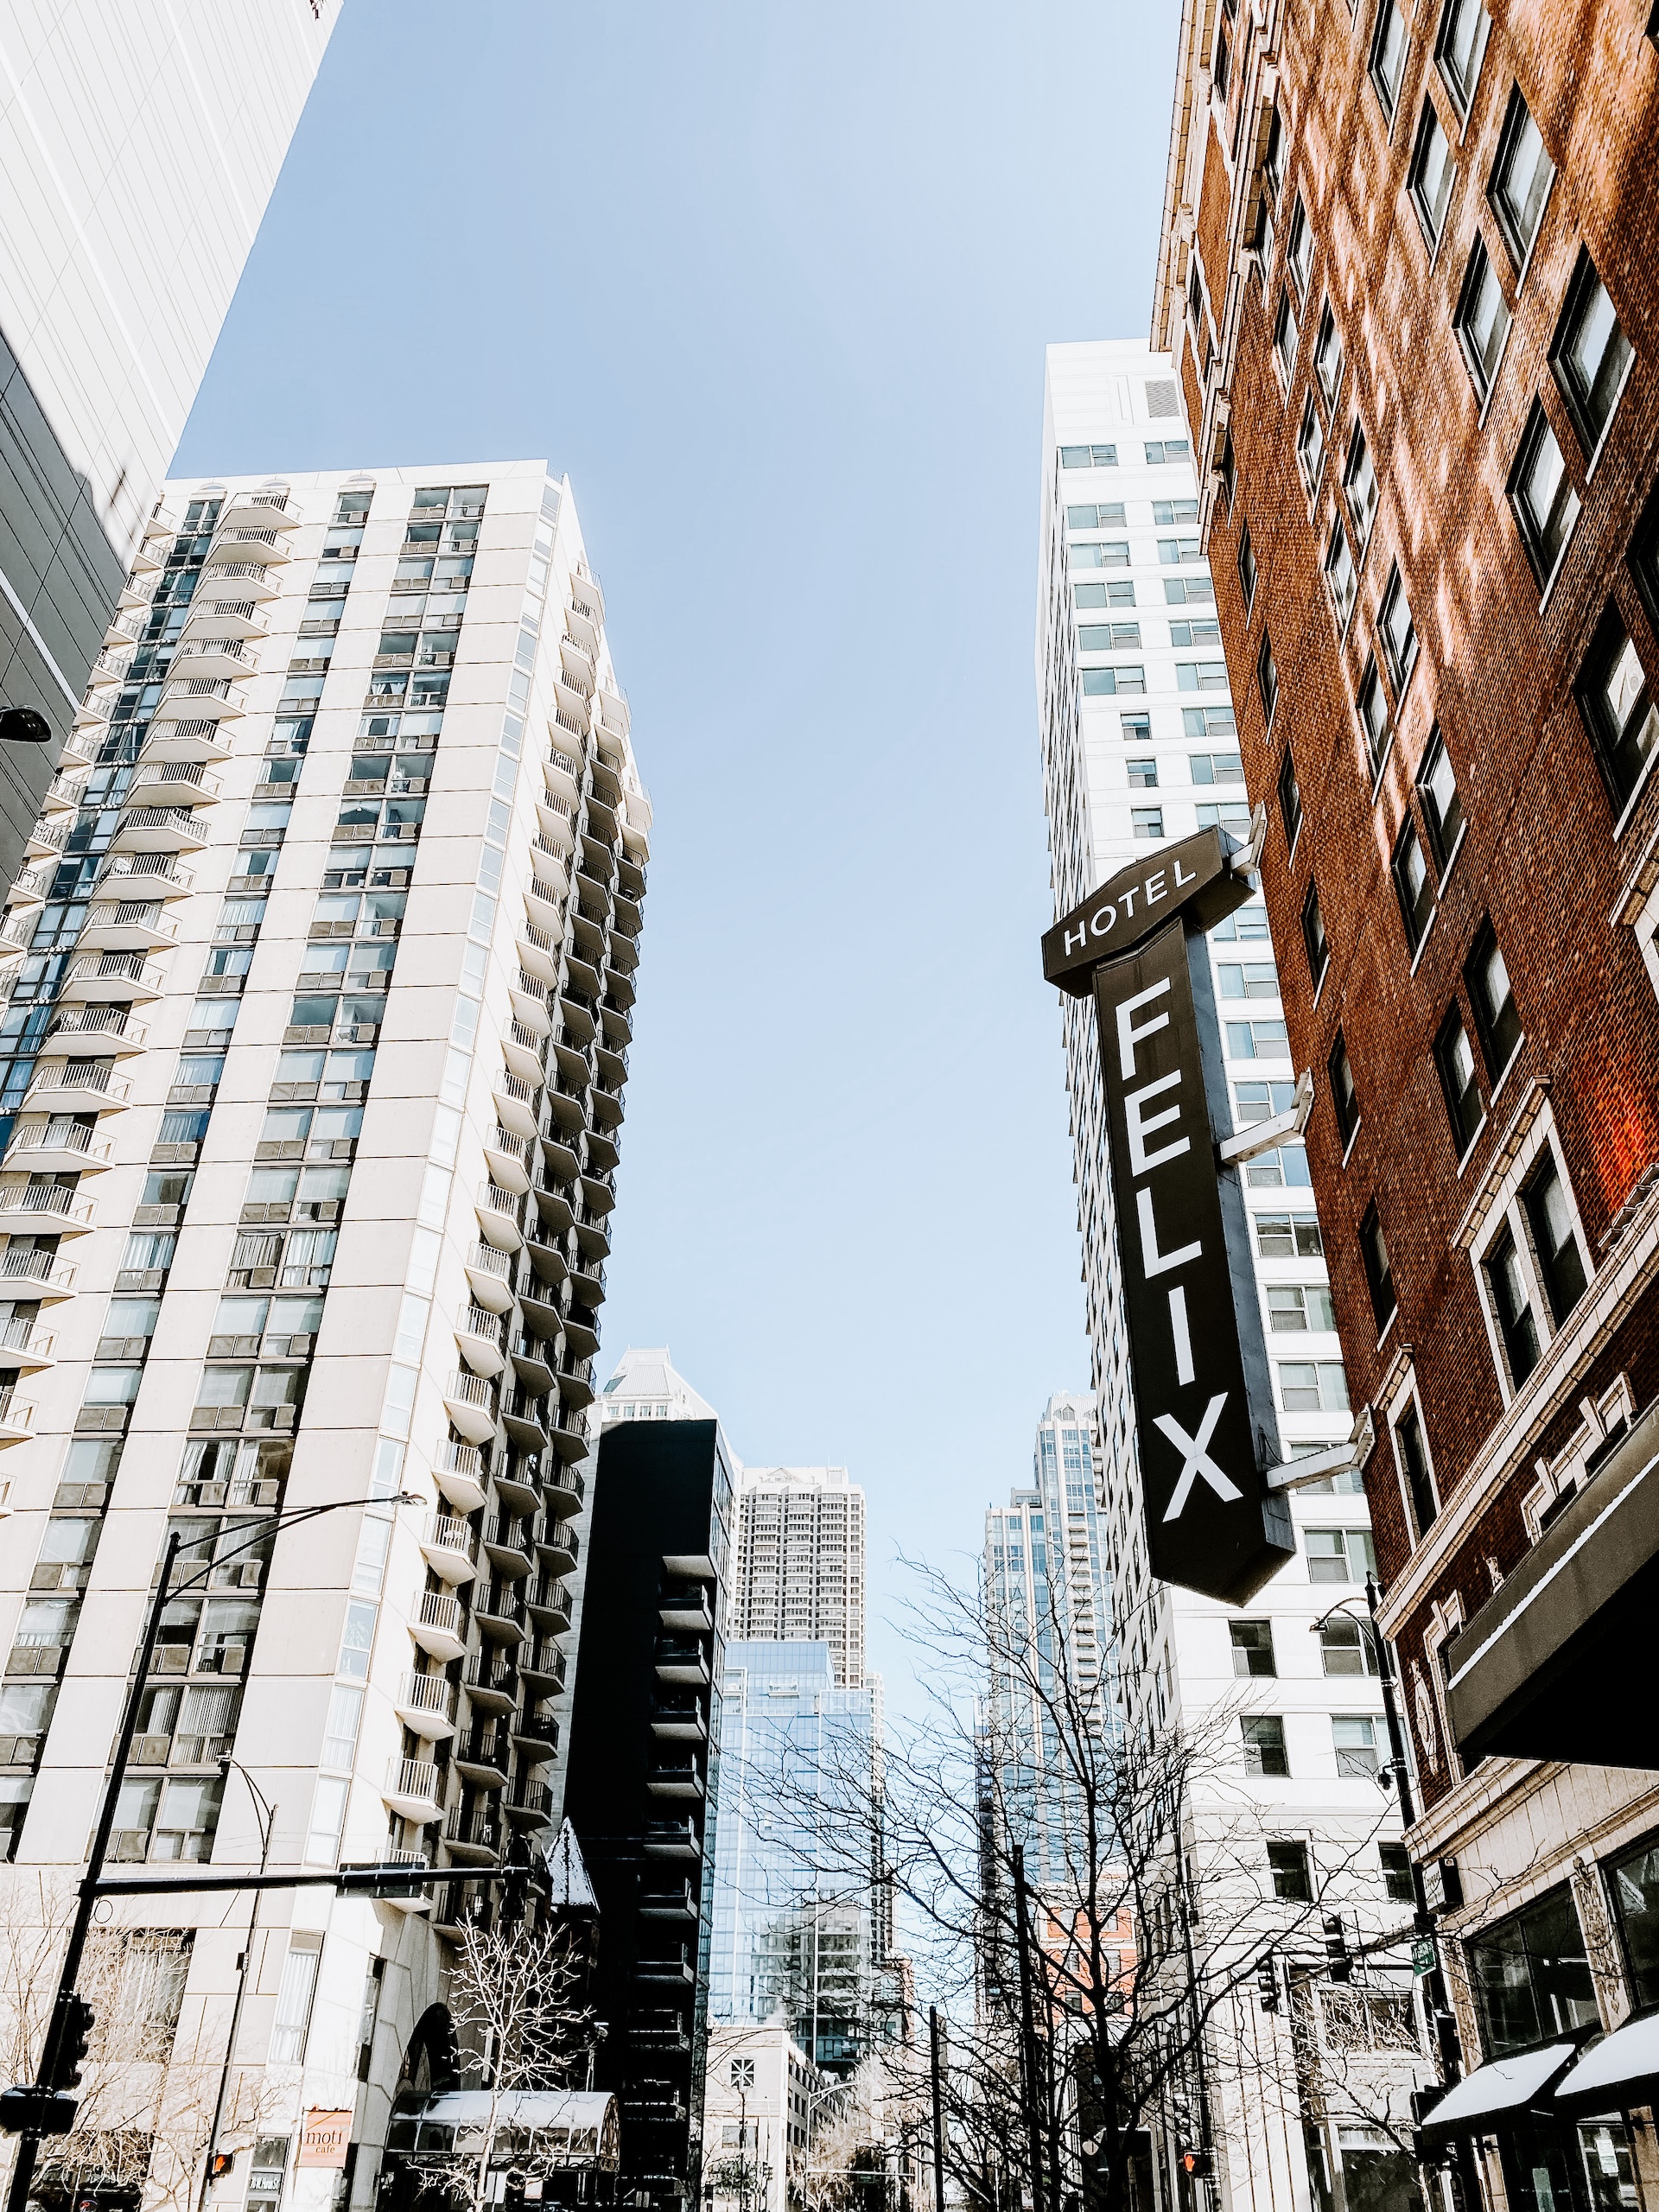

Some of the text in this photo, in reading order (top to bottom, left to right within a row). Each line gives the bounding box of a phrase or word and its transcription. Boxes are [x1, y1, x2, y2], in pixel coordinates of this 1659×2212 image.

[1064, 860, 1197, 957] HOTEL
[1116, 977, 1244, 1522] FELIX
[315, 2144, 335, 2153] cafe
